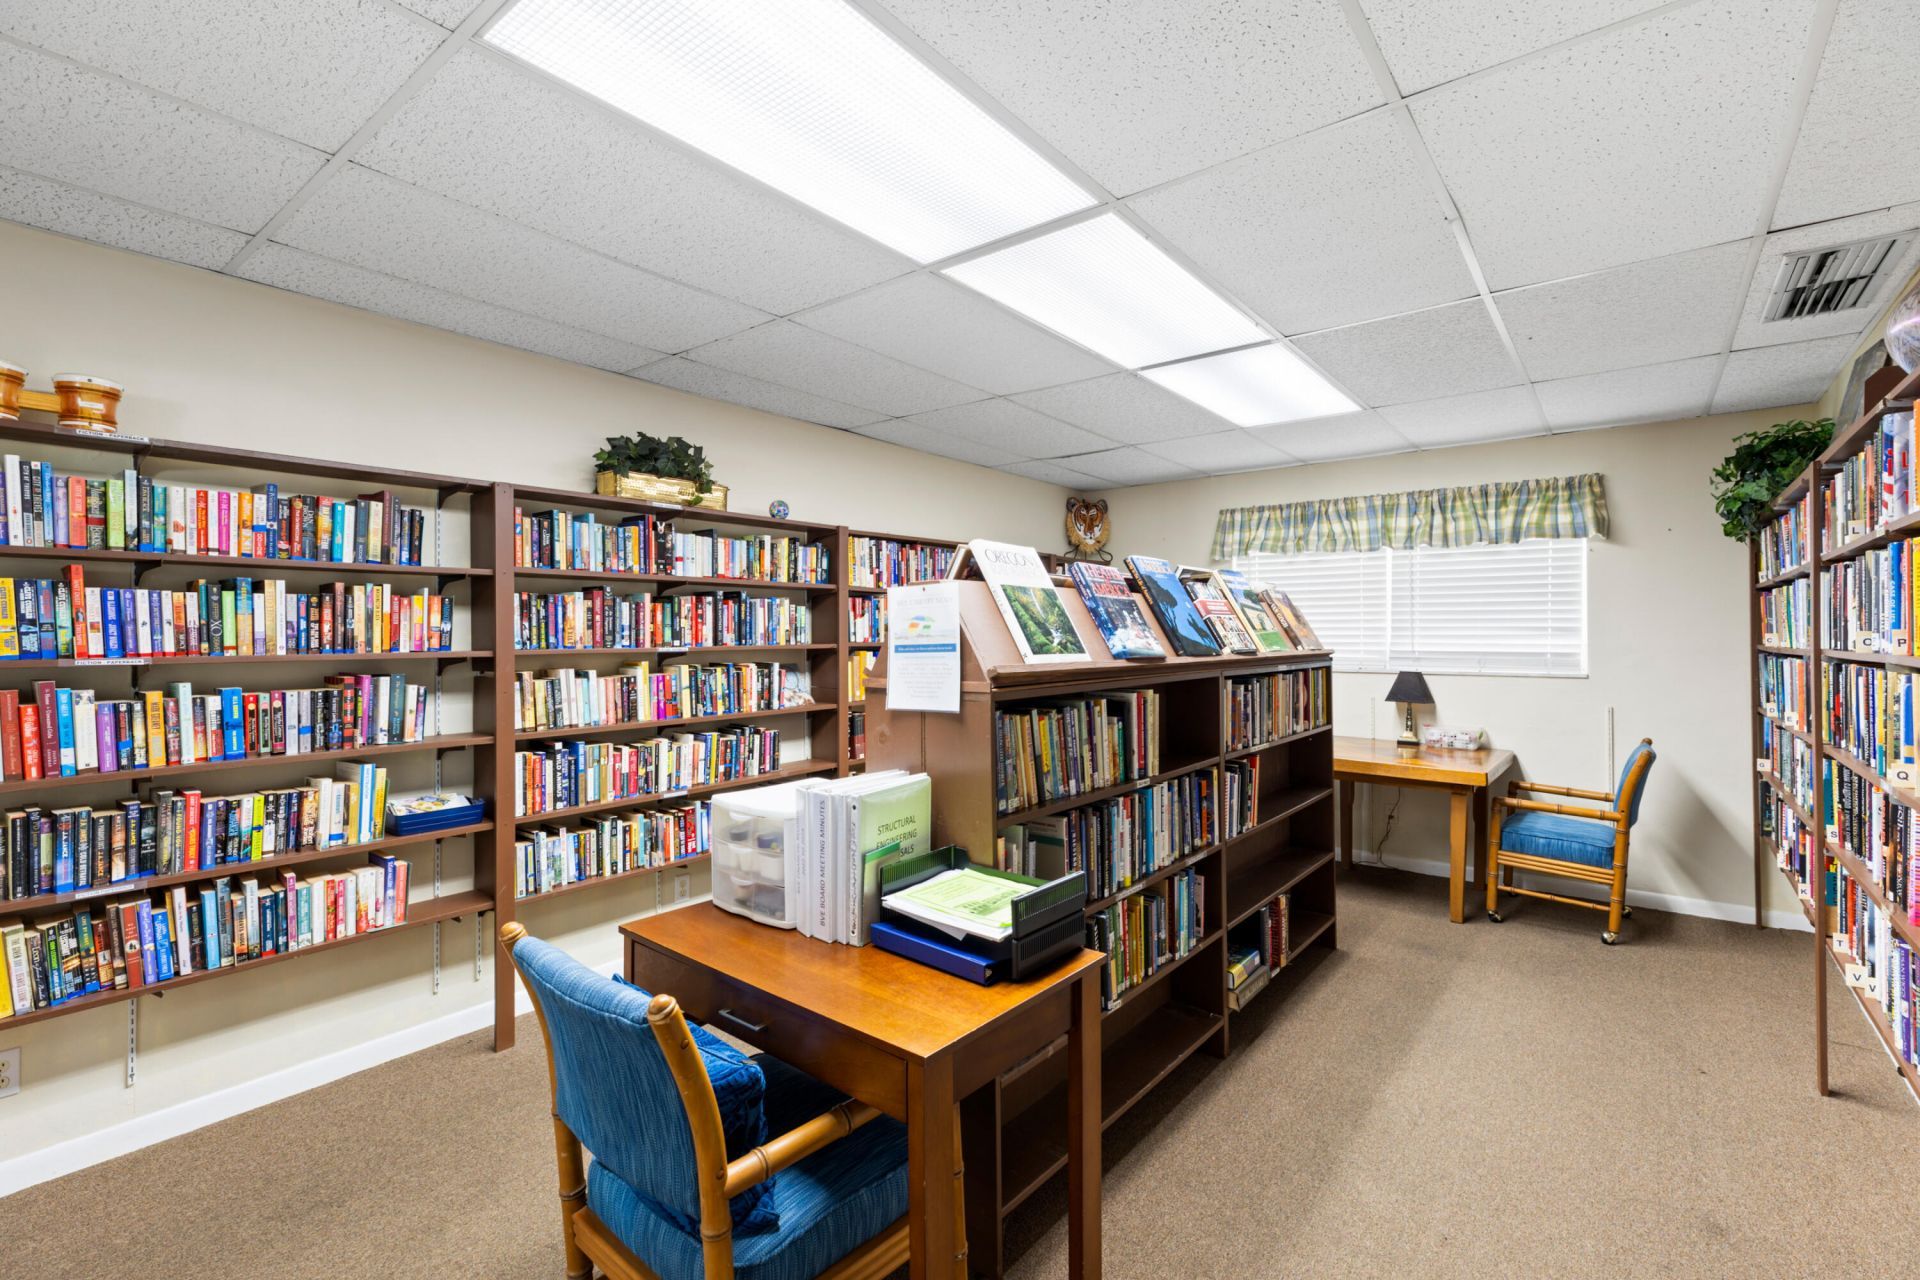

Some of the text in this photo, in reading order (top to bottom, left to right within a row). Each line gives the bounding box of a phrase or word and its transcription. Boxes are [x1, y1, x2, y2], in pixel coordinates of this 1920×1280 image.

[78, 429, 104, 437] FICTION
[211, 620, 222, 636] XO
[1897, 639, 1907, 648] P
[1897, 770, 1909, 781] Q
[877, 815, 916, 835] STRUCTURAL
[876, 828, 917, 849] ENGINEERING
[1830, 831, 1838, 839] S
[1853, 973, 1862, 982] V
[1869, 984, 1877, 993] V
